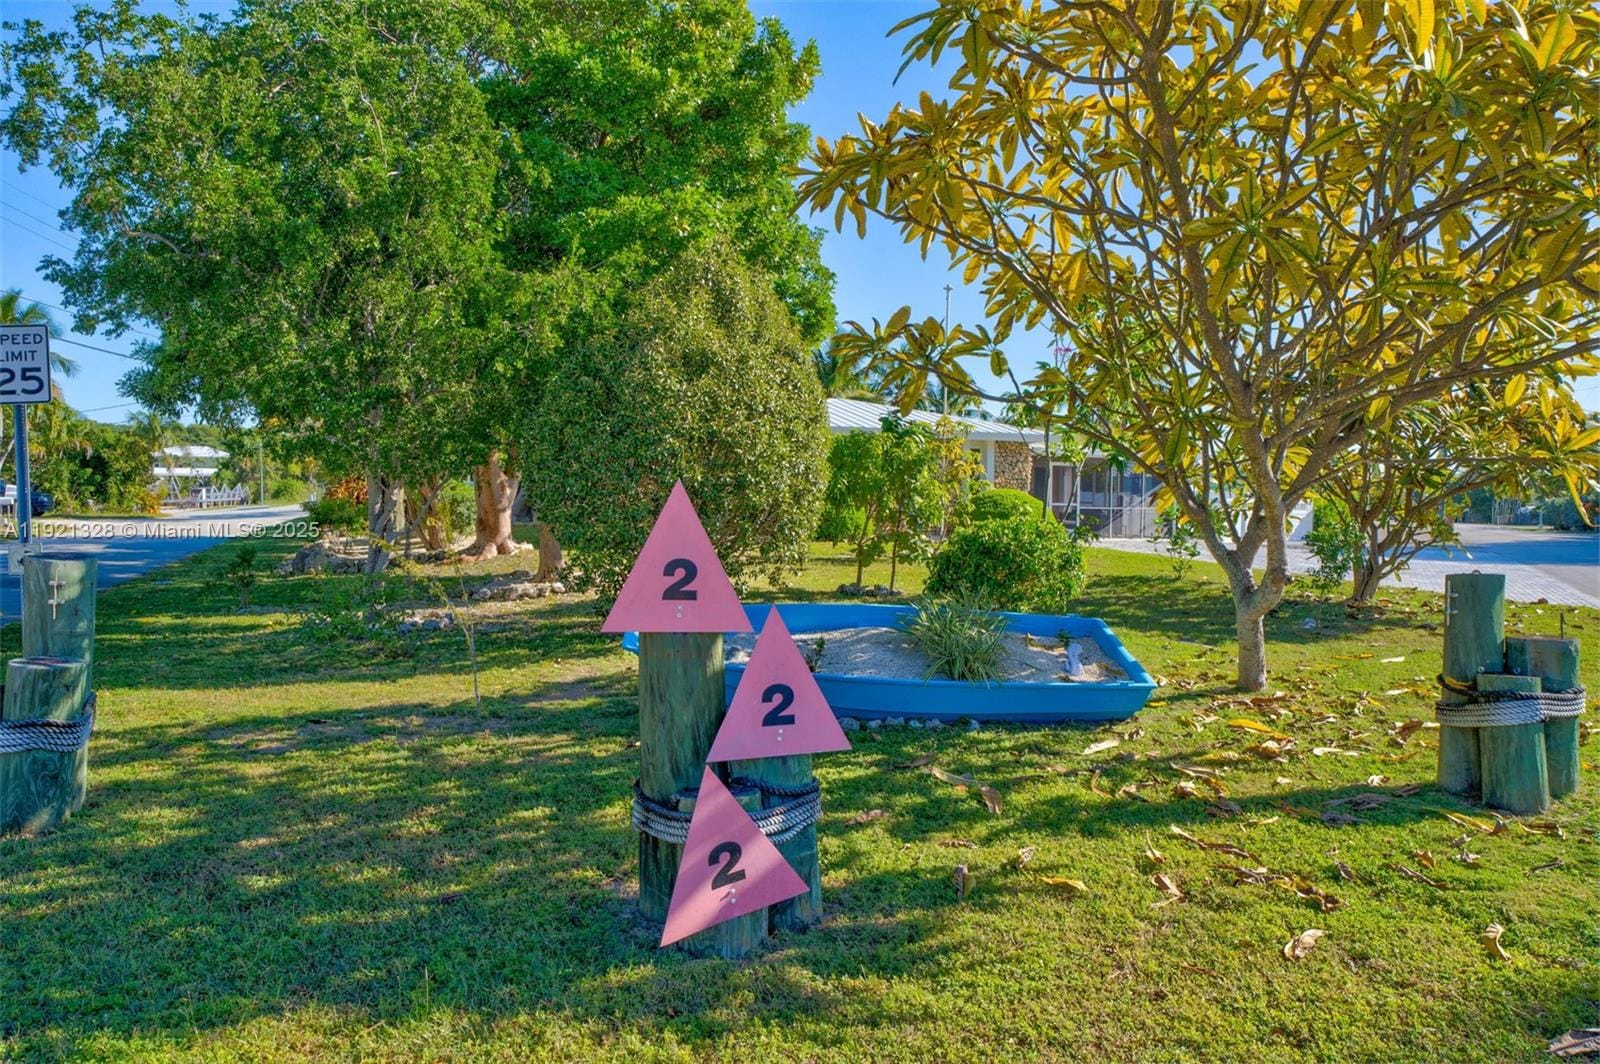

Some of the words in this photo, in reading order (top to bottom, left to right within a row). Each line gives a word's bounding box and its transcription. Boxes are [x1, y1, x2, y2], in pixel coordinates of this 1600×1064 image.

[0, 333, 43, 345] PEED
[0, 367, 44, 395] 25
[661, 558, 698, 601] 2
[761, 684, 796, 727] 2
[707, 841, 747, 891] 2
